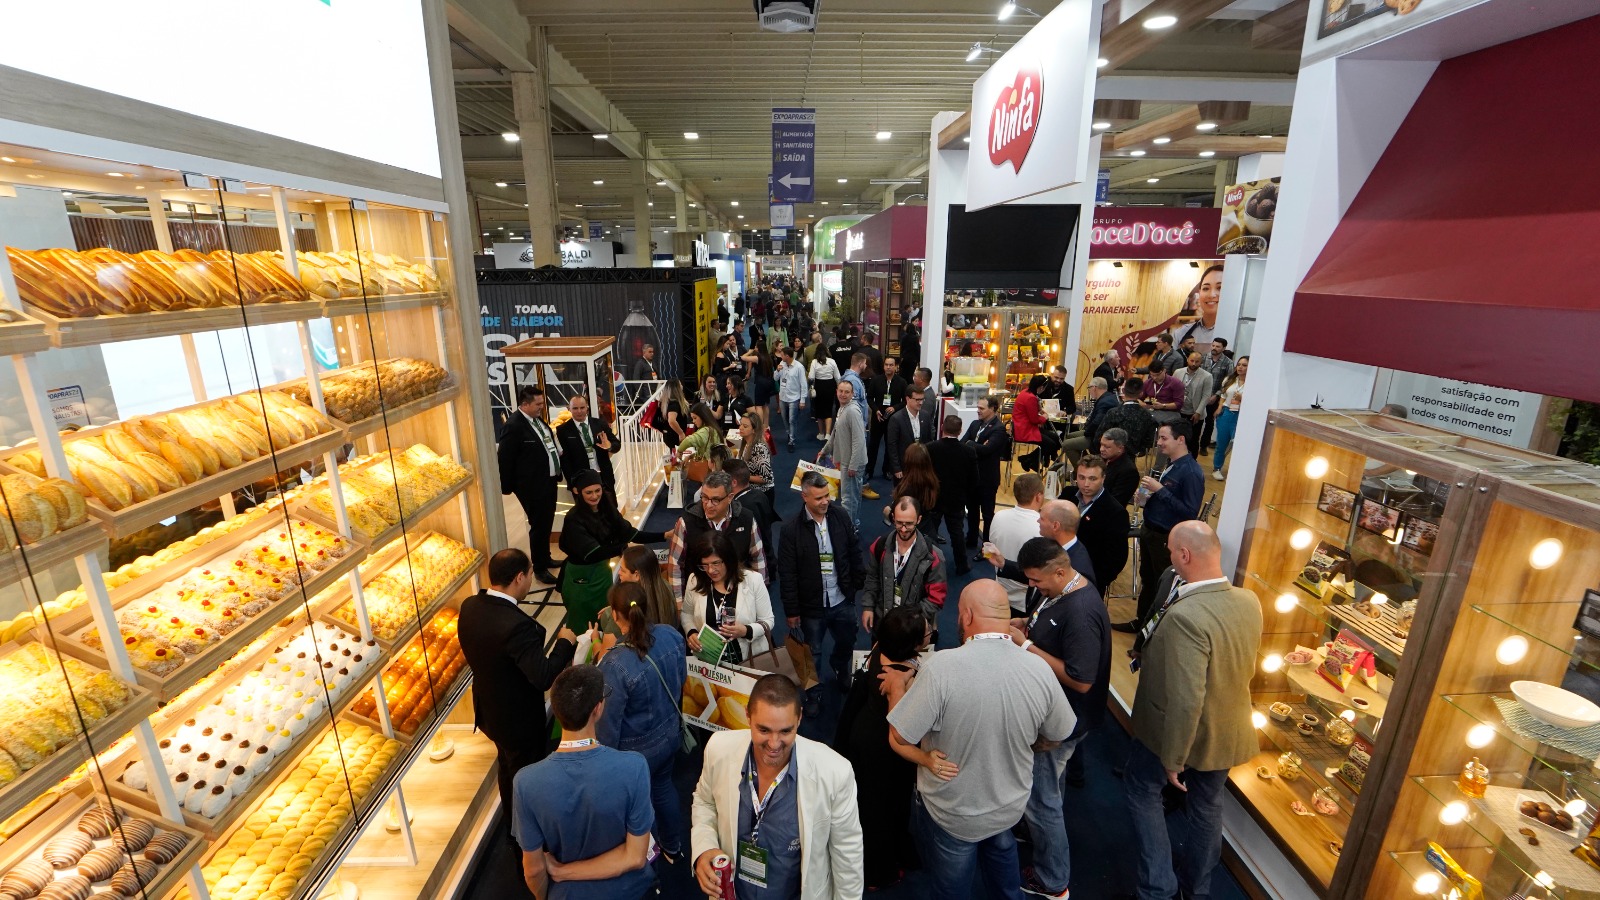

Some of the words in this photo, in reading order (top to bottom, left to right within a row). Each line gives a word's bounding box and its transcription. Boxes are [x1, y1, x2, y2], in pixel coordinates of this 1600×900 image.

[991, 76, 1035, 154] Ninfa
[782, 153, 806, 162] SAÍDA
[1090, 220, 1195, 245] oceD'ocê
[1093, 293, 1109, 301] ser
[514, 304, 557, 314] TOMA
[1082, 305, 1140, 314] ARANAENSE!
[511, 315, 564, 327] SABOR
[1440, 385, 1492, 402] satisfação
[1494, 396, 1520, 408] com
[1411, 393, 1495, 418] responsabilidade
[1497, 412, 1516, 423] em
[1411, 406, 1437, 420] todos
[1438, 414, 1449, 423] os
[1451, 417, 1512, 437] momentos!
